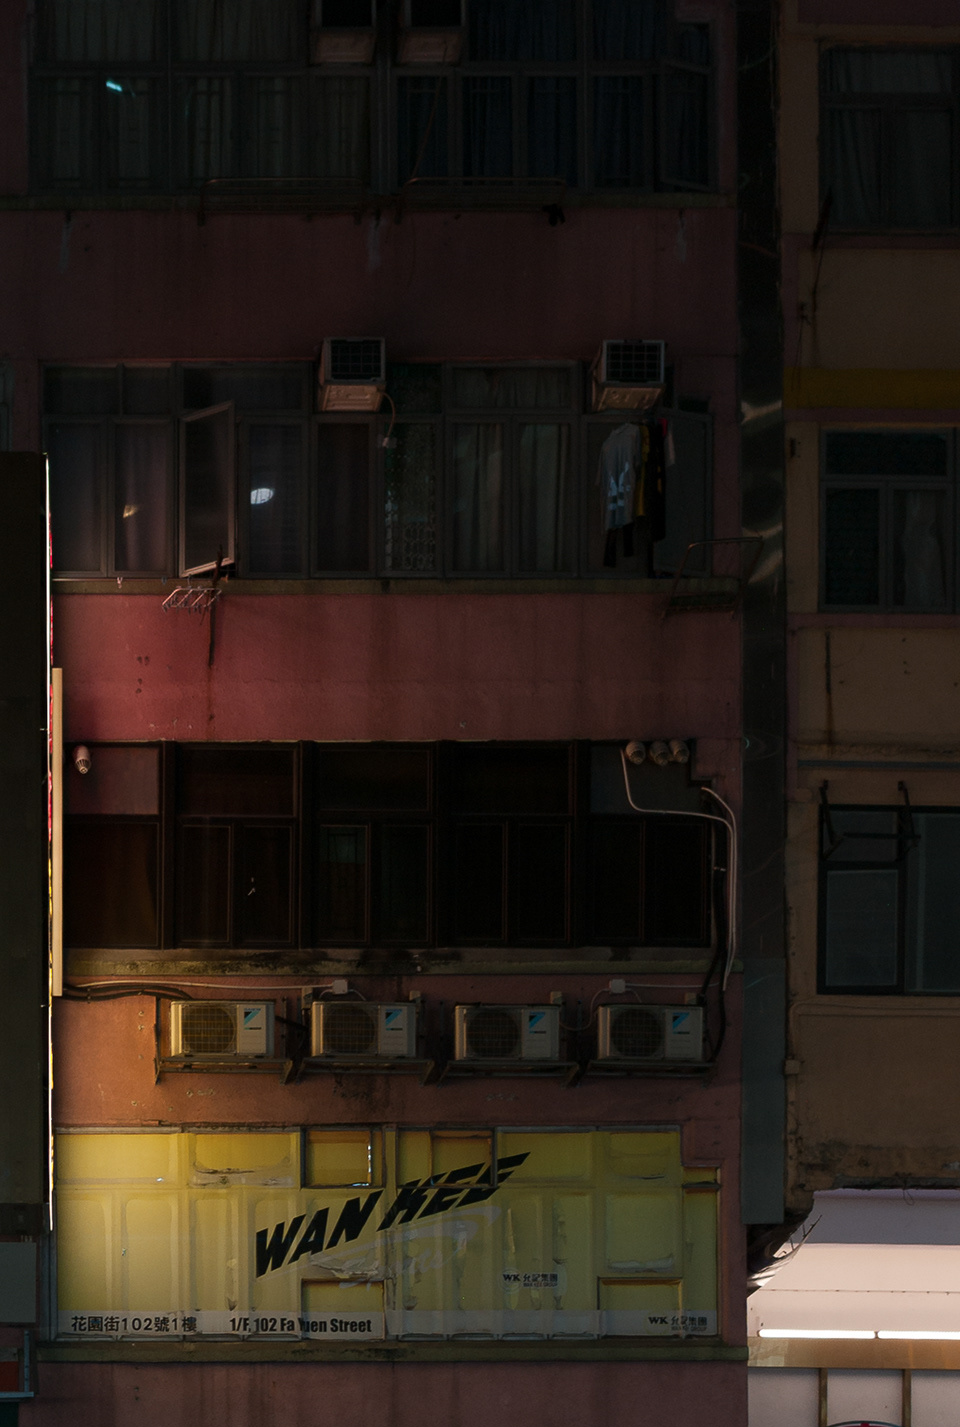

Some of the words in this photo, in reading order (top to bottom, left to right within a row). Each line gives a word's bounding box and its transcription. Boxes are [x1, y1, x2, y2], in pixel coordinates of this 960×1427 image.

[256, 1189, 384, 1278] WAN
[377, 1152, 531, 1231] KEE
[503, 1274, 520, 1282] WK
[71, 1316, 197, 1332] 花園街102號1樓
[254, 1318, 277, 1332] 102
[280, 1318, 295, 1332] Fa
[298, 1318, 327, 1332] Yuen
[330, 1318, 372, 1332] Street
[648, 1317, 667, 1325] WK
